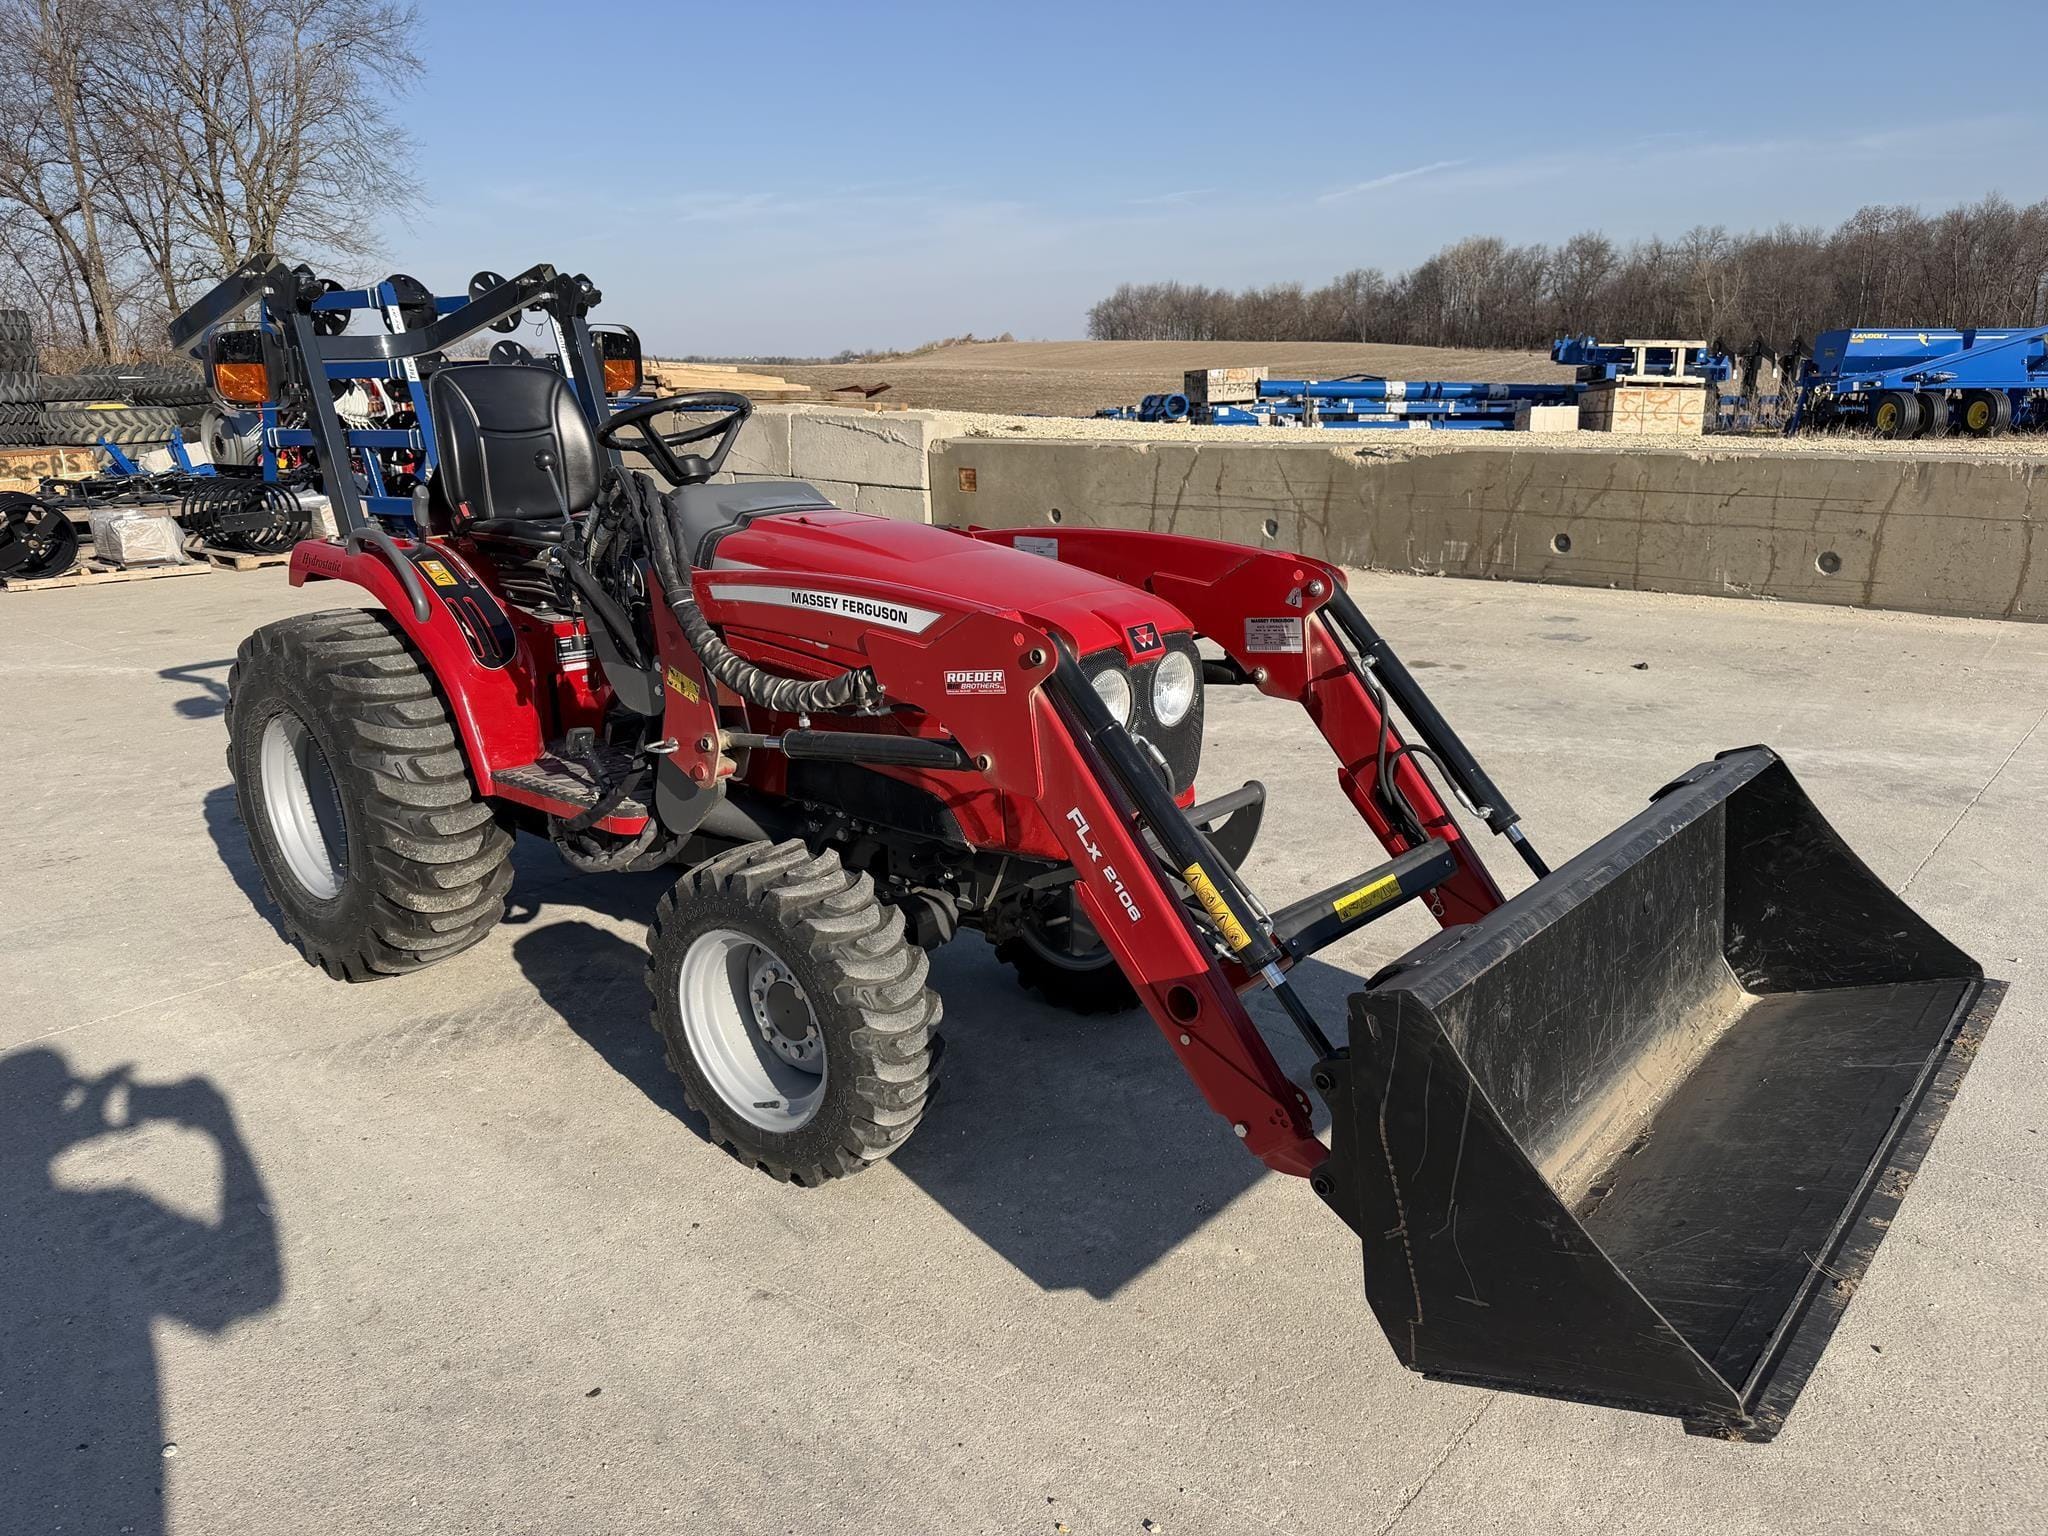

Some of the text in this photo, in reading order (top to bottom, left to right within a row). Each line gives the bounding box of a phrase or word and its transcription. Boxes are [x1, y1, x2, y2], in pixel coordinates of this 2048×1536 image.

[302, 552, 342, 573] Hydrostatic
[791, 592, 908, 624] MASSEY FERGUSON
[947, 671, 1003, 682] ROEDER
[1102, 865, 1142, 922] 2106
